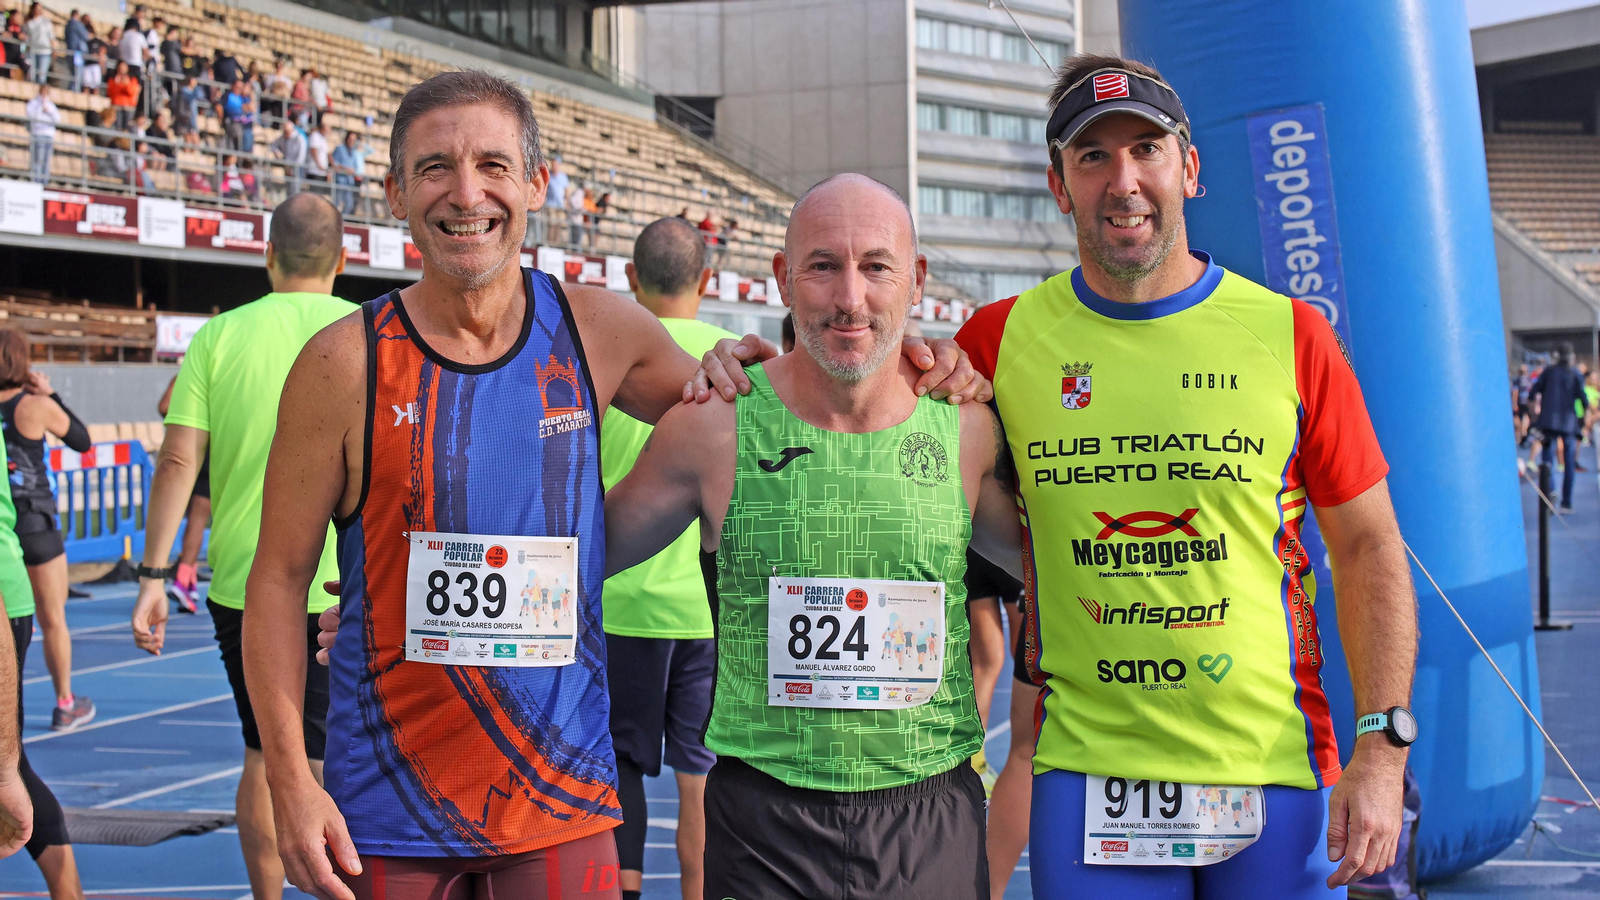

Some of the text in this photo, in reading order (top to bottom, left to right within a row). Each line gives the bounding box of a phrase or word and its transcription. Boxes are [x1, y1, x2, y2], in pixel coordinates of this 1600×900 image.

[1182, 373, 1238, 390] GOBIK
[538, 409, 590, 428] PUERTO REAL
[538, 415, 592, 439] C.D. MARATON
[901, 438, 912, 455] CLUB
[922, 435, 947, 466] ATLETISMO
[1028, 429, 1264, 460] CLUB TRIATLÓN
[1034, 462, 1252, 488] PUERTO REAL
[427, 541, 485, 553] XLII CARRERA
[1071, 533, 1228, 570] Meycagesal
[443, 551, 483, 562] POPULAR
[1098, 570, 1144, 578] Fabricación
[1153, 569, 1188, 577] Montaje
[427, 569, 507, 619] 839
[787, 585, 845, 597] XLII CARRERA
[854, 591, 864, 599] 23
[804, 595, 843, 605] POPULAR
[1103, 598, 1231, 630] infisport
[423, 618, 439, 627] JOSÉ
[461, 621, 492, 629] CASARES
[493, 622, 523, 630] OROPESA
[1170, 622, 1194, 630] SCIENCE
[788, 614, 869, 661] 824
[795, 662, 876, 672] MANUEL ÁLVAREZ GORDO
[1097, 658, 1187, 684] sano
[1141, 682, 1187, 691] PUERTO REAL
[1104, 776, 1183, 819] 919
[1120, 822, 1146, 830] MANUEL
[1147, 822, 1172, 830] TORRES
[1173, 822, 1201, 830] ROMERO
